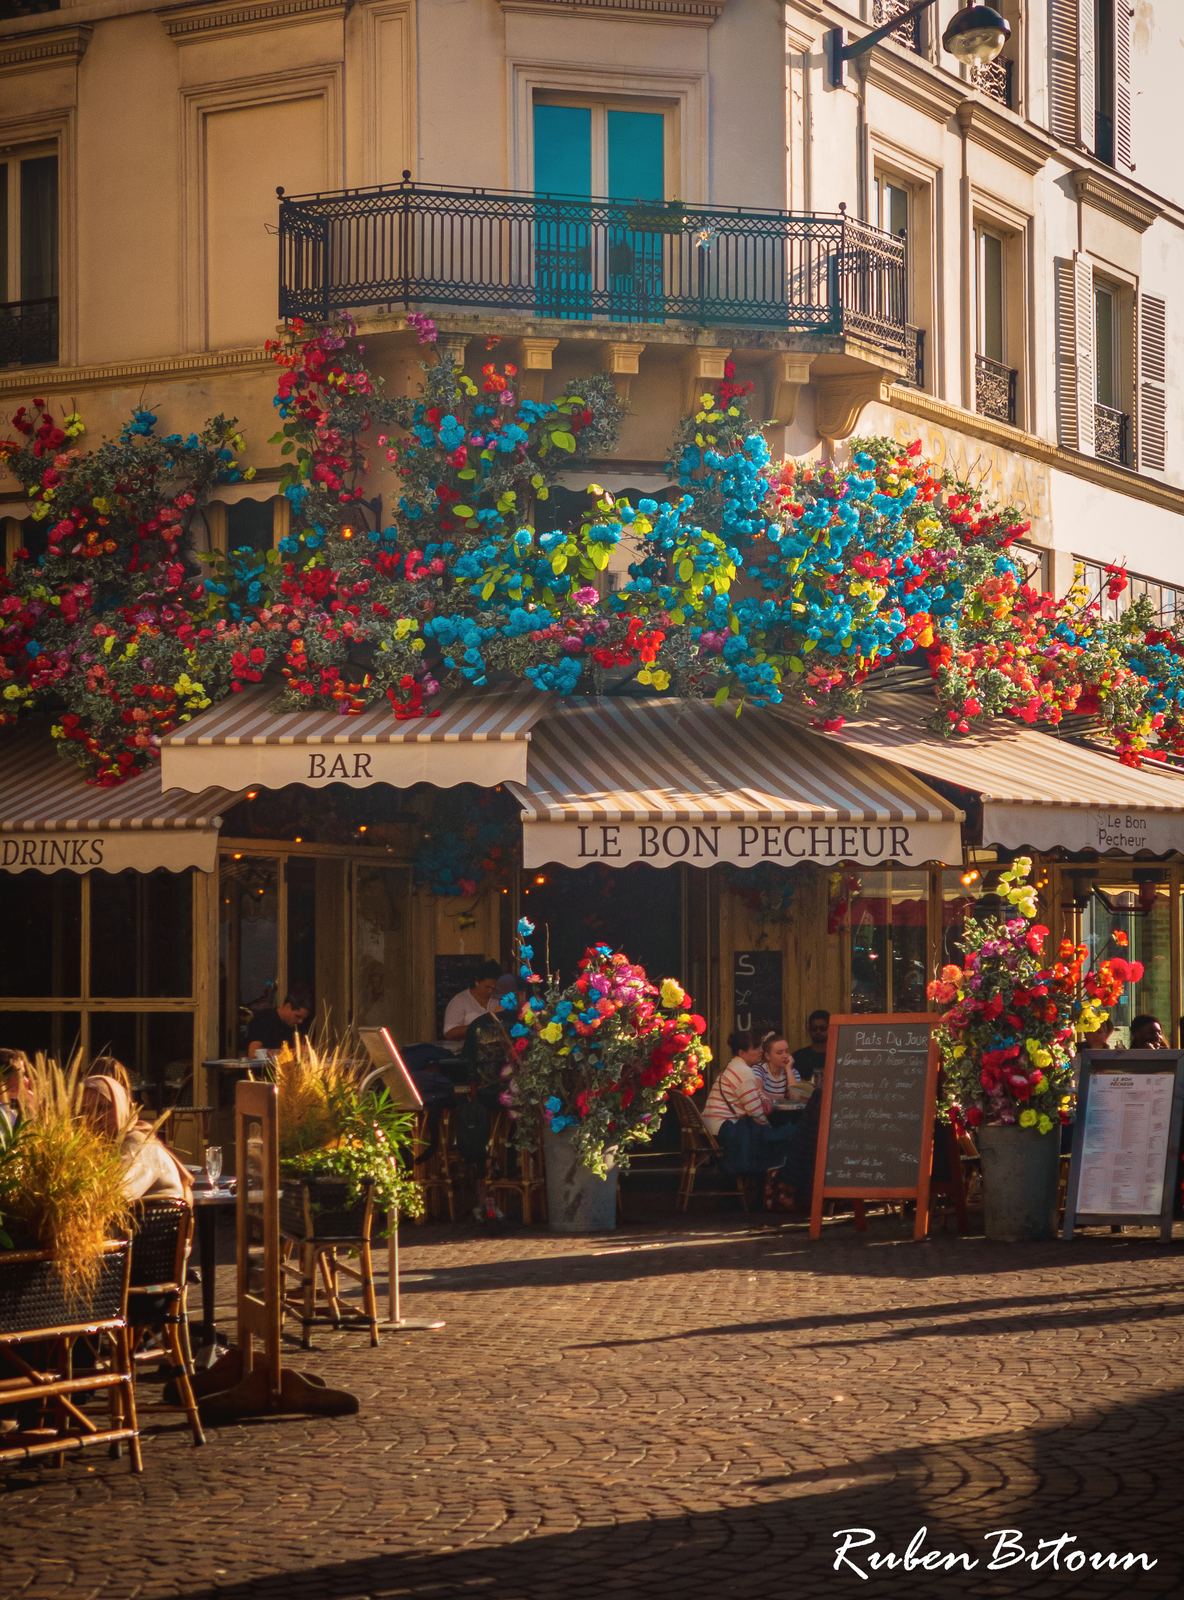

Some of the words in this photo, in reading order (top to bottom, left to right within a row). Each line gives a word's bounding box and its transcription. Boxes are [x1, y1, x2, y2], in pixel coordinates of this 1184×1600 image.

[307, 752, 374, 780] BAR
[1107, 814, 1121, 828] Le
[1125, 815, 1147, 829] Bon
[577, 825, 622, 858] LE
[638, 825, 720, 858] BON
[738, 825, 914, 858] PECHEUR
[1098, 828, 1148, 847] Pecheur
[2, 838, 104, 867] DRINKS
[856, 1032, 882, 1046] Plats
[886, 1031, 902, 1047] Du
